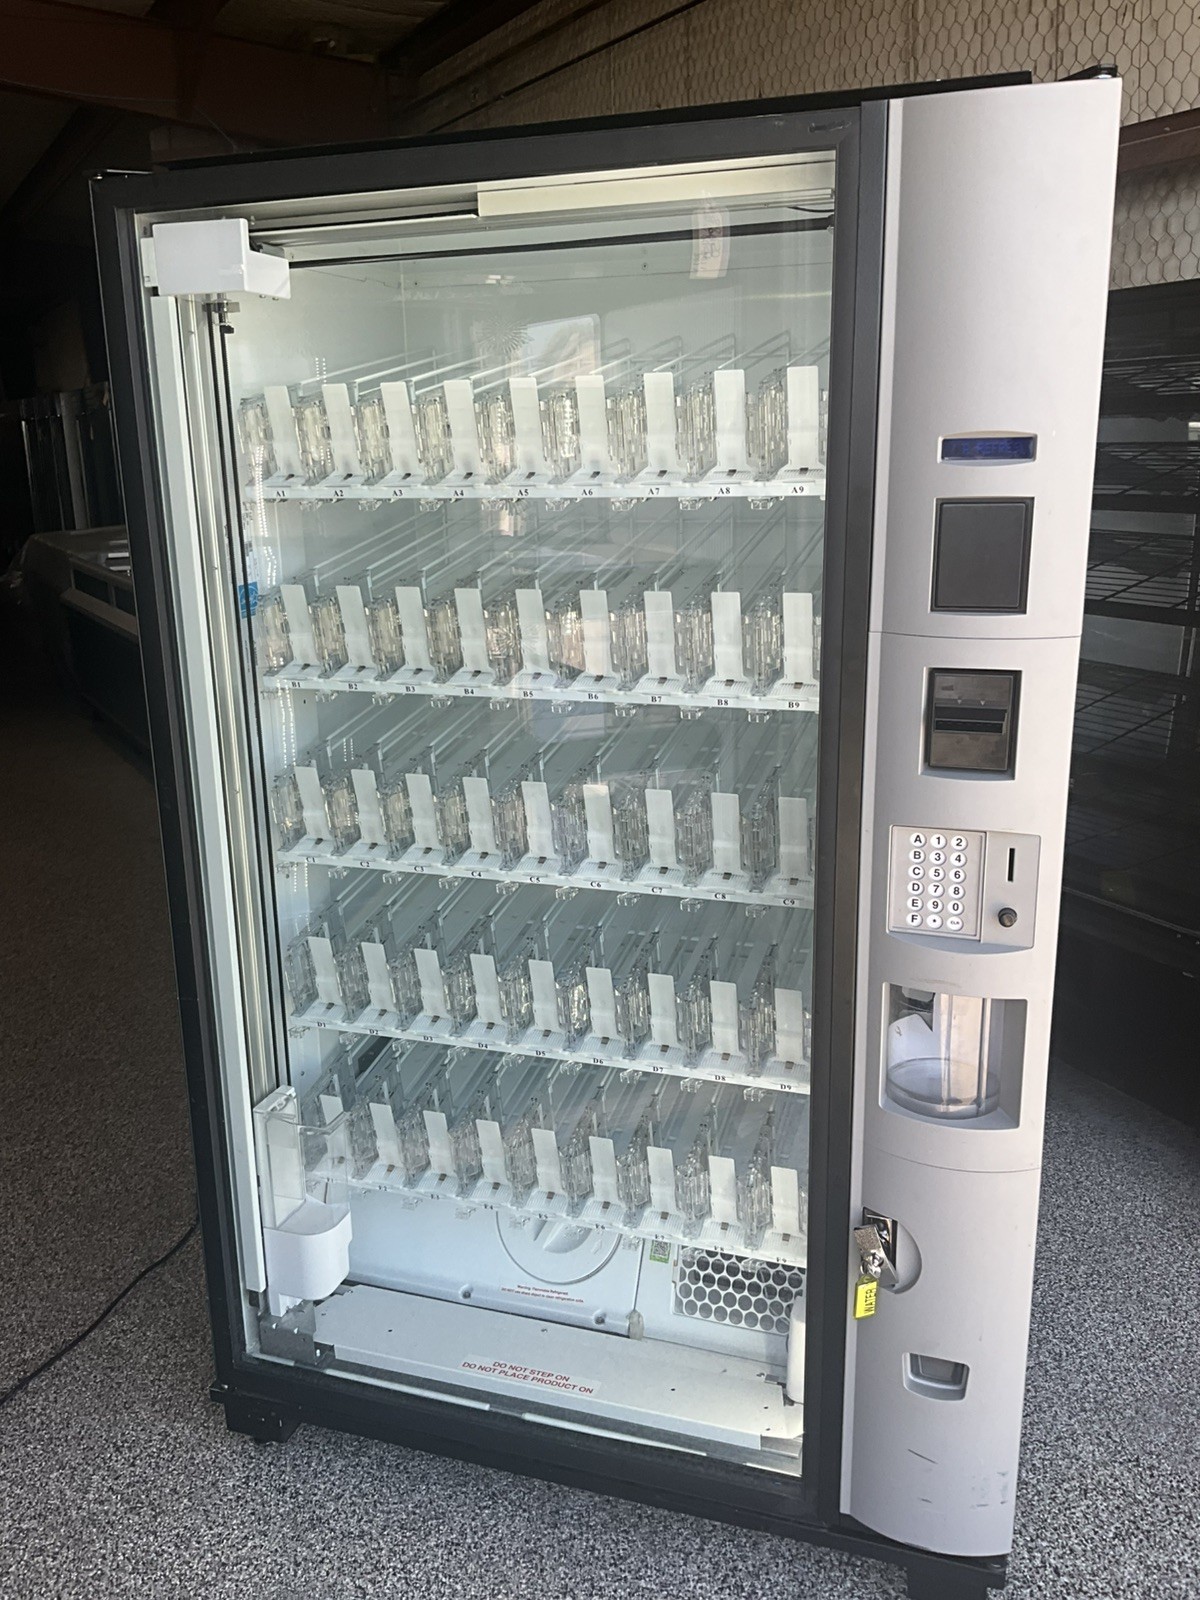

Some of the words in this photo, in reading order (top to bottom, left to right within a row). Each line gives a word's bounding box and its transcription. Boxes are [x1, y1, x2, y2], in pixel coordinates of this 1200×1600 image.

[518, 488, 529, 496] A5
[581, 488, 594, 496] A6
[719, 487, 731, 495] A8
[792, 486, 805, 494] A9
[405, 685, 416, 693] B3
[788, 701, 800, 709] B9
[914, 835, 922, 843] A
[935, 837, 941, 845] 1
[956, 838, 963, 847] 2
[913, 851, 921, 860] B
[934, 853, 941, 861] 3
[955, 855, 961, 863] 4
[912, 867, 921, 876] C
[933, 869, 940, 877] 5
[954, 871, 961, 879] 6
[912, 883, 920, 891] D
[933, 885, 940, 893] 7
[953, 887, 960, 895] 8
[912, 899, 919, 907] E
[932, 901, 939, 909] 9
[953, 903, 959, 911] 0
[911, 915, 918, 923] F
[864, 1288, 876, 1314] WATER
[478, 1365, 498, 1374] NOT
[498, 1369, 530, 1380] PLACE
[531, 1376, 578, 1390] PRODUCT
[508, 1364, 527, 1373] NOT
[529, 1369, 554, 1378] STEP
[556, 1374, 570, 1382] ON
